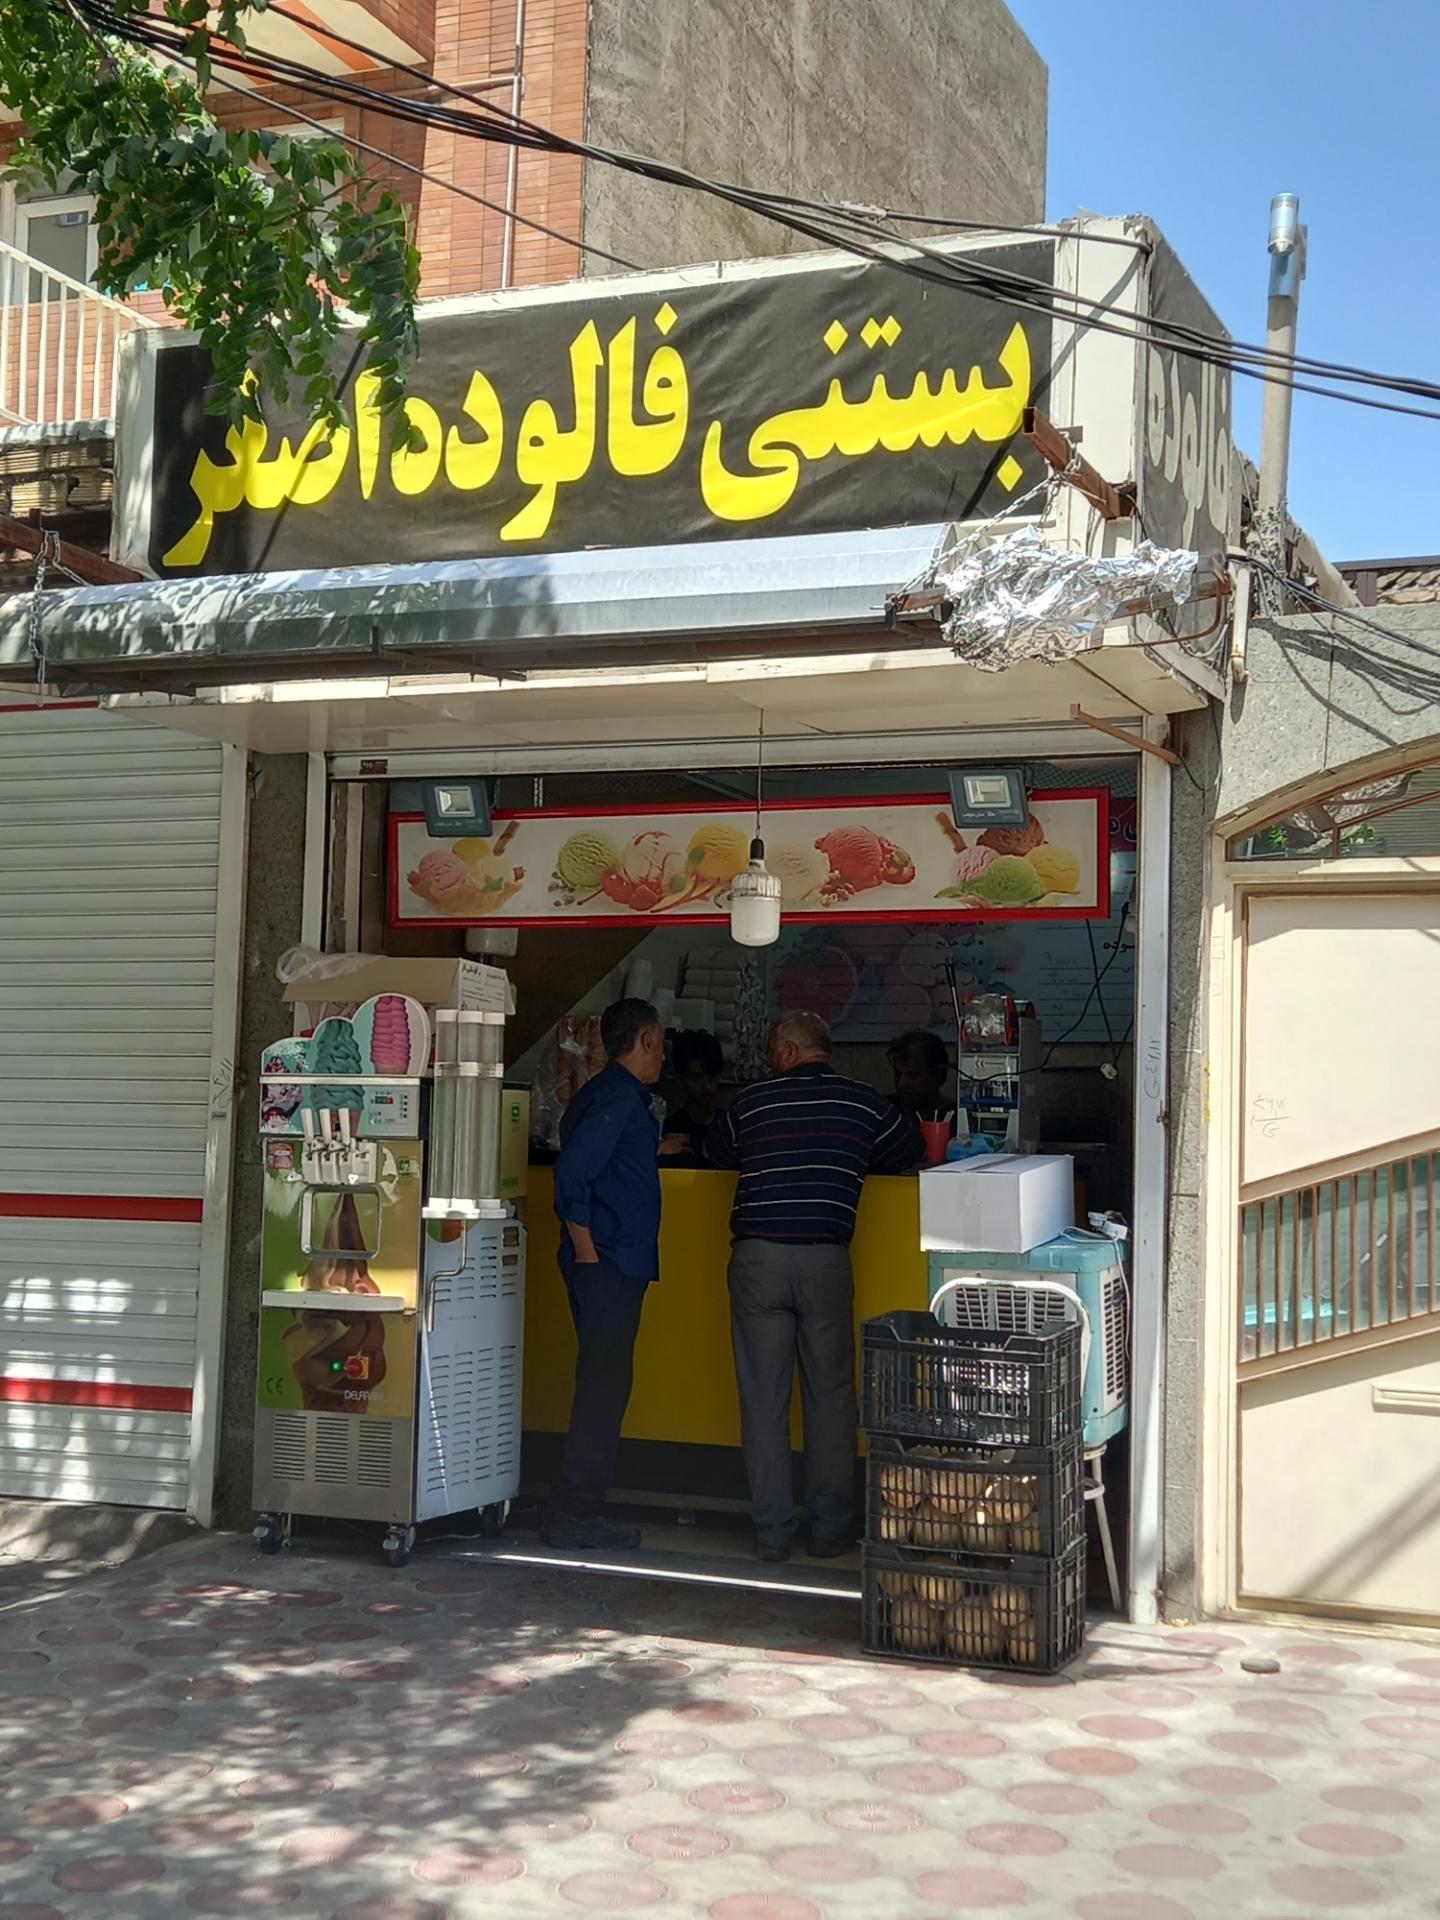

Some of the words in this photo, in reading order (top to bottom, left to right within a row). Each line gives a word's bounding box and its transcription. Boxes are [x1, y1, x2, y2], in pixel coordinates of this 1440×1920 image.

[390, 301, 689, 541] فالوده
[700, 315, 1032, 522] بستنی
[1147, 344, 1230, 550] فالوده
[265, 1376, 284, 1395] CE
